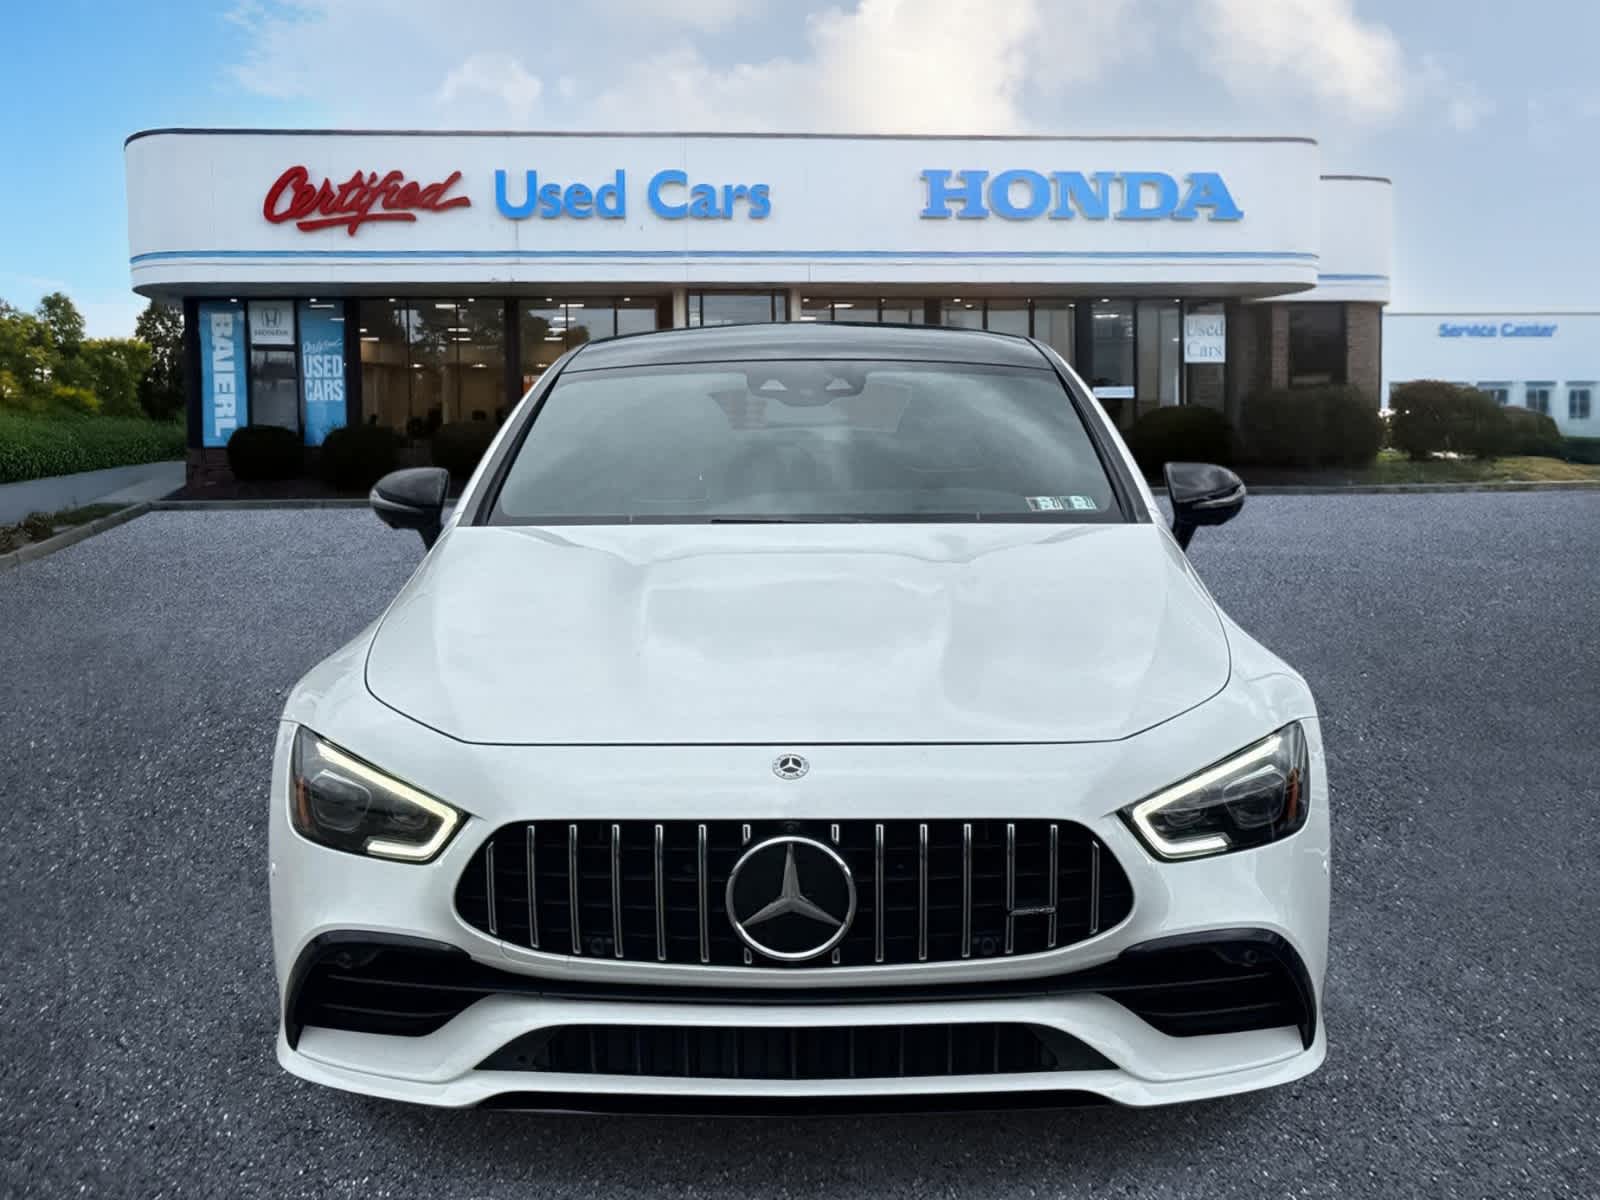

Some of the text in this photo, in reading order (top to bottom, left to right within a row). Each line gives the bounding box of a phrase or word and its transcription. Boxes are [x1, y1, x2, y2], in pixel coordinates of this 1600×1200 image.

[263, 165, 771, 237] Certified Used Cars
[920, 169, 1245, 221] HONDA
[1186, 318, 1224, 337] Used
[1438, 322, 1558, 338] Service Center
[1186, 340, 1224, 359] Cars
[211, 313, 237, 437] BAIERL
[303, 355, 343, 378] USED
[304, 379, 345, 402] CARS
